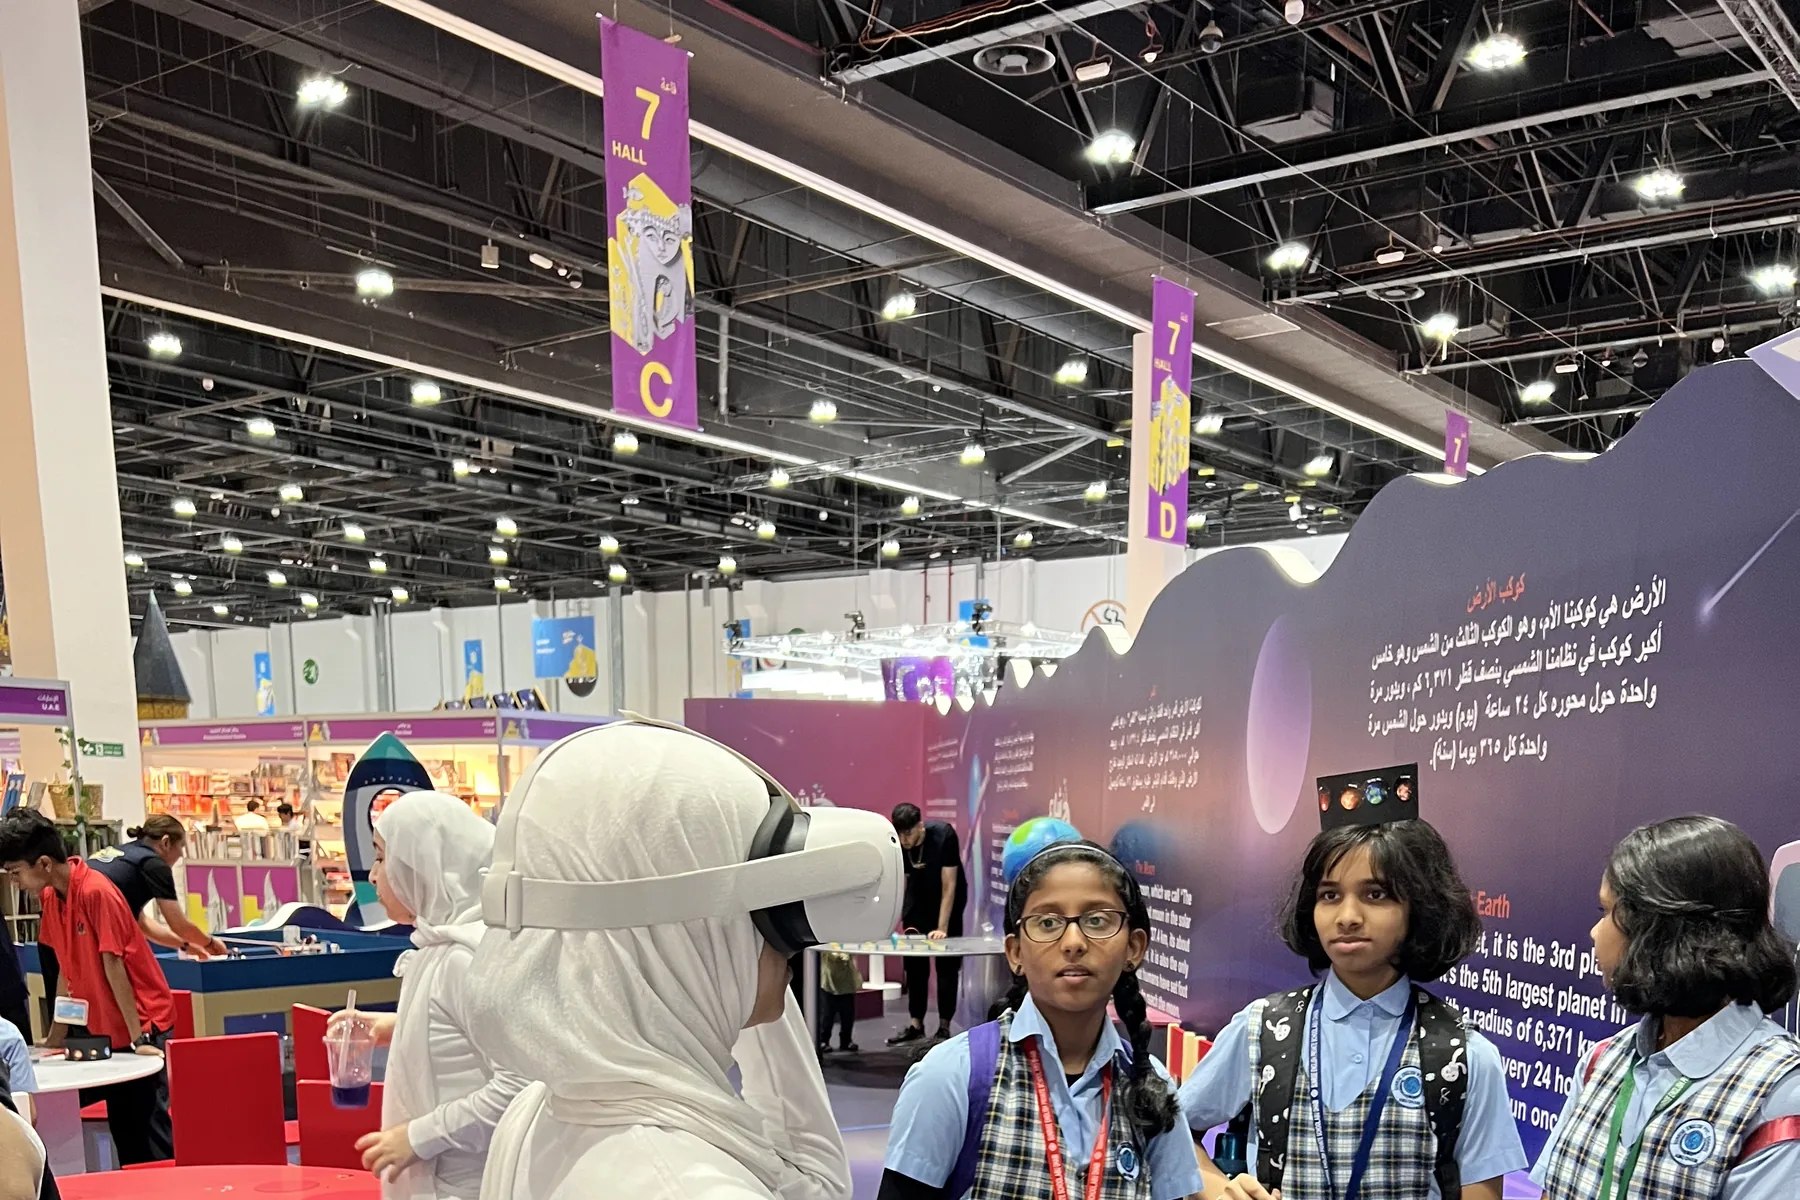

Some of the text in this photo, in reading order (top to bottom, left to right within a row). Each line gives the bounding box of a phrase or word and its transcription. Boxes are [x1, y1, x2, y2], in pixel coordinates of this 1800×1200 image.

[635, 86, 660, 140] 7
[612, 139, 647, 166] HALL
[1168, 320, 1180, 355] 7
[640, 361, 673, 418] C
[1454, 437, 1462, 464] 7
[1160, 502, 1176, 539] D
[1467, 572, 1526, 613] كوكب الأرض
[1621, 574, 1666, 619] الأرض
[1564, 595, 1598, 629] كوكبنا
[1598, 594, 1618, 629] هي
[1456, 621, 1480, 647] الثالث
[1481, 615, 1513, 647] الكوكب
[1515, 616, 1536, 641] وهو
[1634, 621, 1663, 664] أكبر
[1371, 643, 1393, 670] خامس
[1394, 644, 1411, 666] وهو
[1412, 632, 1440, 662] الشمس
[1441, 634, 1454, 657] من
[1545, 642, 1578, 670] نظامنا
[1578, 635, 1596, 676] في
[1598, 633, 1632, 668] كوكب
[1454, 659, 1473, 691] قطر
[1473, 658, 1502, 684] بنصف
[1503, 649, 1543, 688] الشمسي
[1370, 680, 1383, 704] مرة
[1383, 680, 1406, 702] ويدور
[1368, 677, 1657, 737] واحدة حول محوره كل ٢٤ ساعة (يوم) ويدور حول الشمس مرة
[1480, 737, 1500, 757] ٣٦٥
[1503, 734, 1517, 762] كل
[1518, 733, 1548, 761] واحدة
[1150, 884, 1164, 899] which
[1171, 887, 1180, 903] call
[1477, 890, 1510, 919] Earth
[1152, 908, 1165, 923] moon
[1165, 908, 1170, 923] in
[1170, 910, 1178, 926] the
[1178, 913, 1192, 929] solar
[1176, 935, 1190, 953] about
[1493, 931, 1503, 957] it
[1506, 933, 1518, 960] is
[1523, 936, 1545, 964] the
[1550, 941, 1576, 970] 3rd
[1579, 947, 1603, 979] pla
[1154, 949, 1159, 964] is
[1159, 952, 1169, 968] also
[1170, 956, 1178, 971] the
[1178, 959, 1189, 979] only
[1159, 974, 1170, 992] have
[1170, 980, 1178, 994] set
[1178, 980, 1188, 999] foot
[1460, 964, 1479, 990] the
[1482, 968, 1502, 996] 5th
[1505, 972, 1554, 1009] largest
[1557, 985, 1606, 1021] planet
[1158, 996, 1166, 1011] the
[1473, 1008, 1513, 1037] radius
[1516, 1017, 1533, 1042] of
[1534, 1020, 1573, 1055] 6,371
[1501, 1056, 1531, 1088] very
[1533, 1060, 1551, 1090] 24
[1509, 1098, 1558, 1132] un onc
